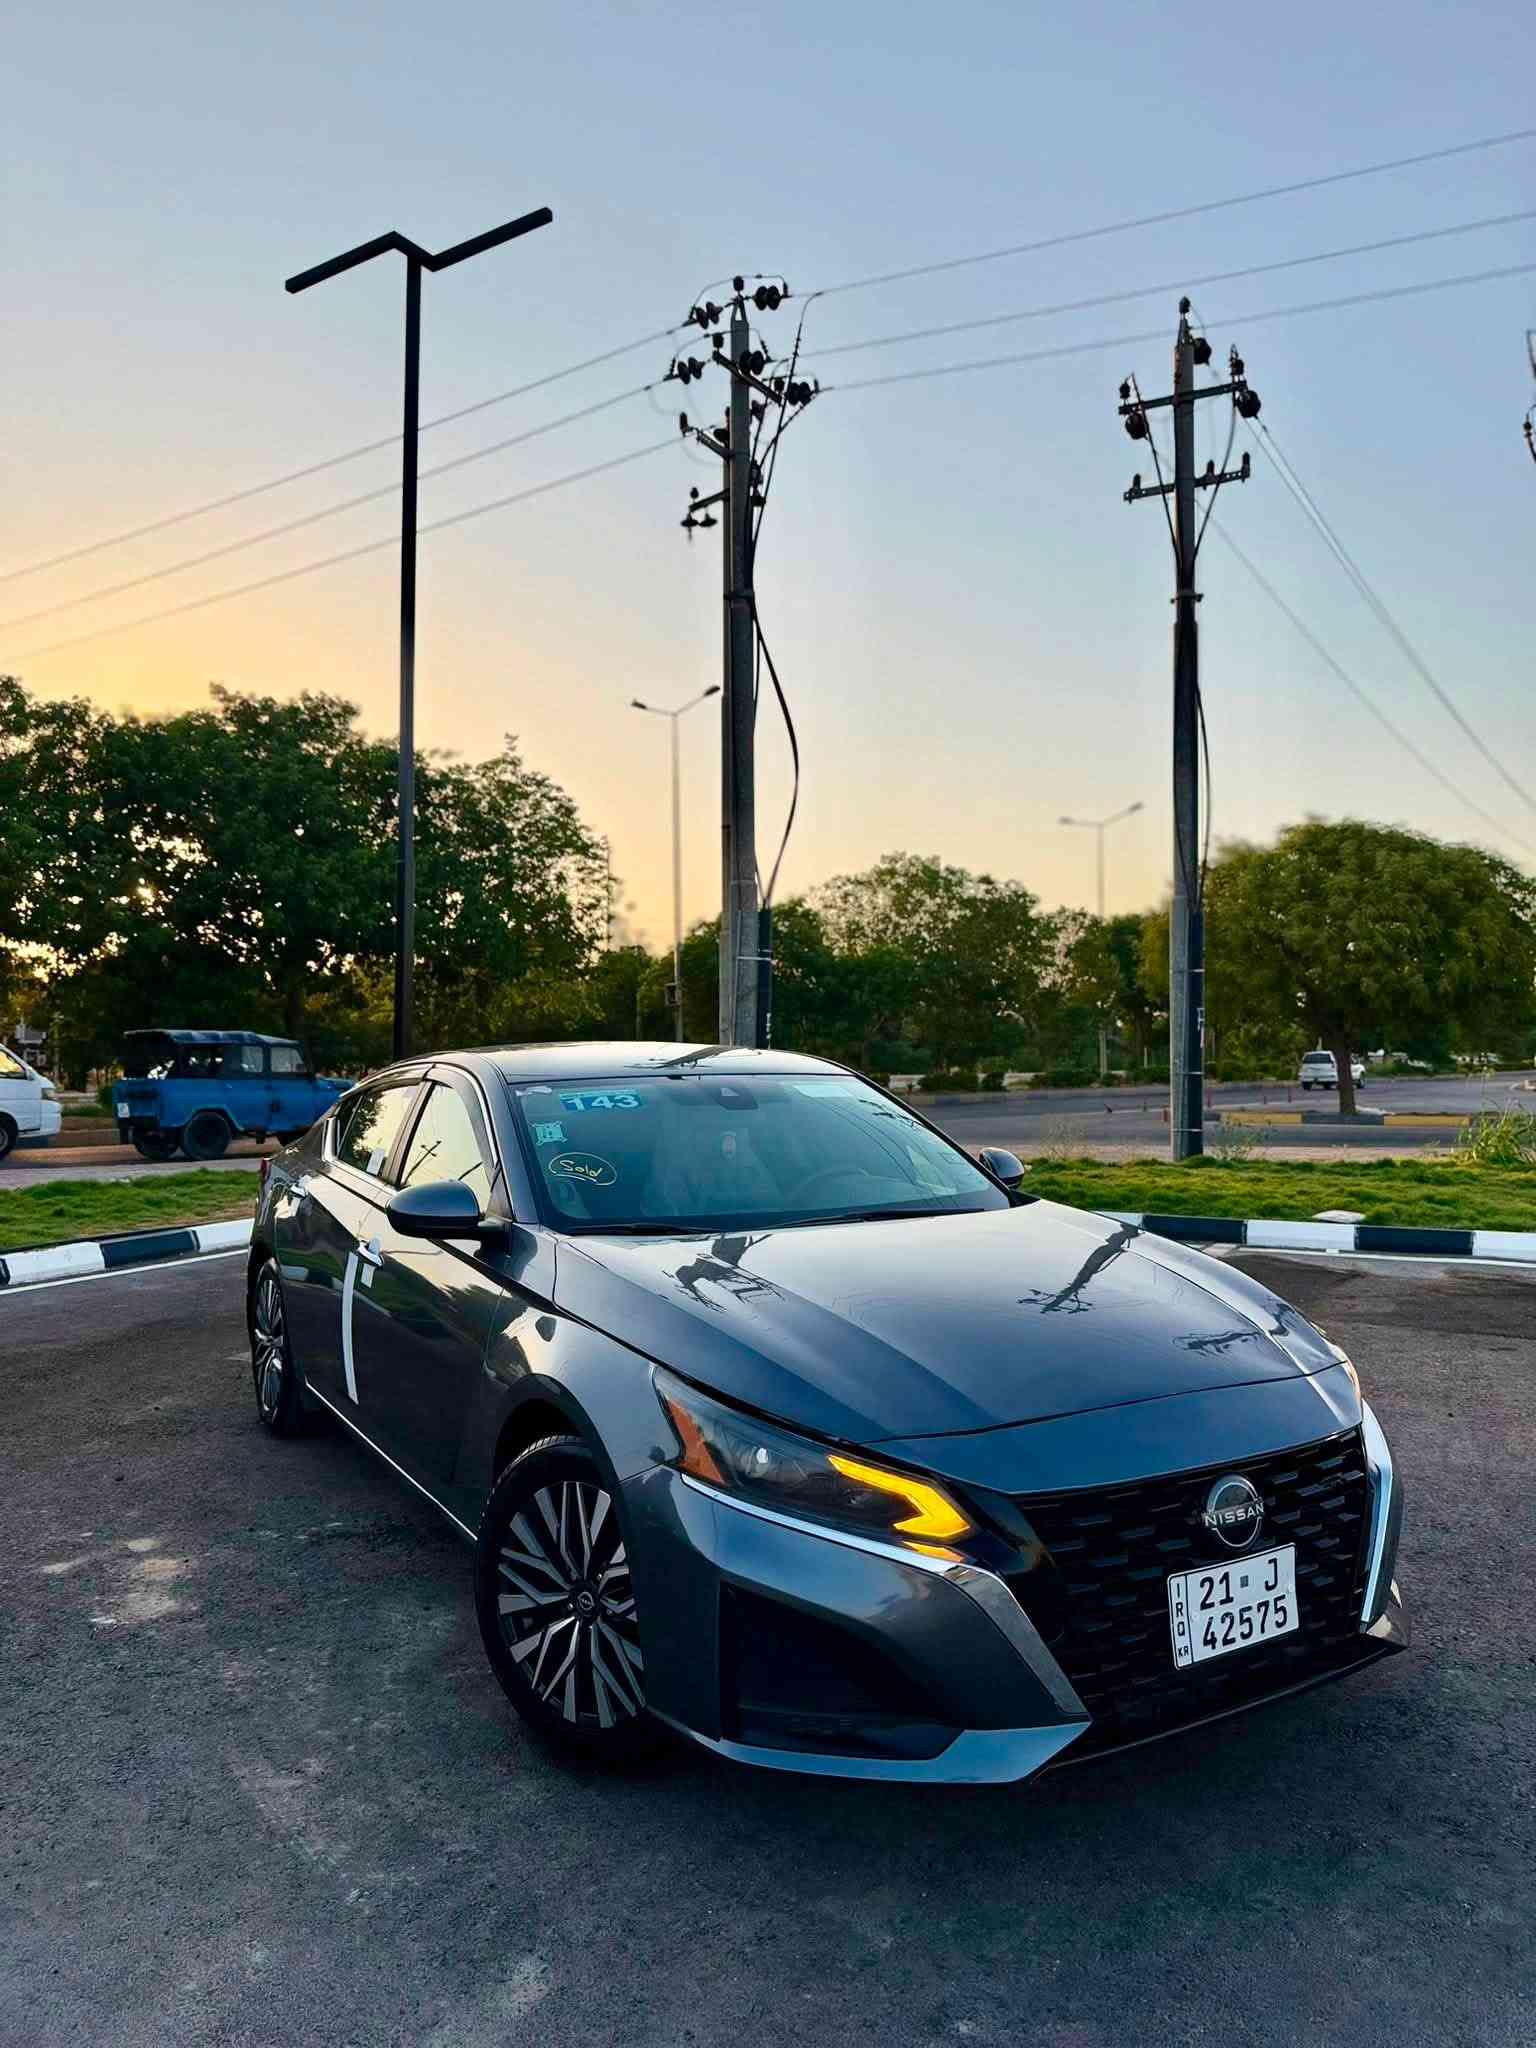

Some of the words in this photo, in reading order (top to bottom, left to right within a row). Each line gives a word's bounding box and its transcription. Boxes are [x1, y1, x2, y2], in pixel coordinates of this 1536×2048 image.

[559, 1160, 602, 1177] Sold
[1205, 1502, 1264, 1527] NISSAN
[1199, 1572, 1234, 1611] 21
[1264, 1557, 1278, 1592] J
[1202, 1594, 1288, 1650] 42575
